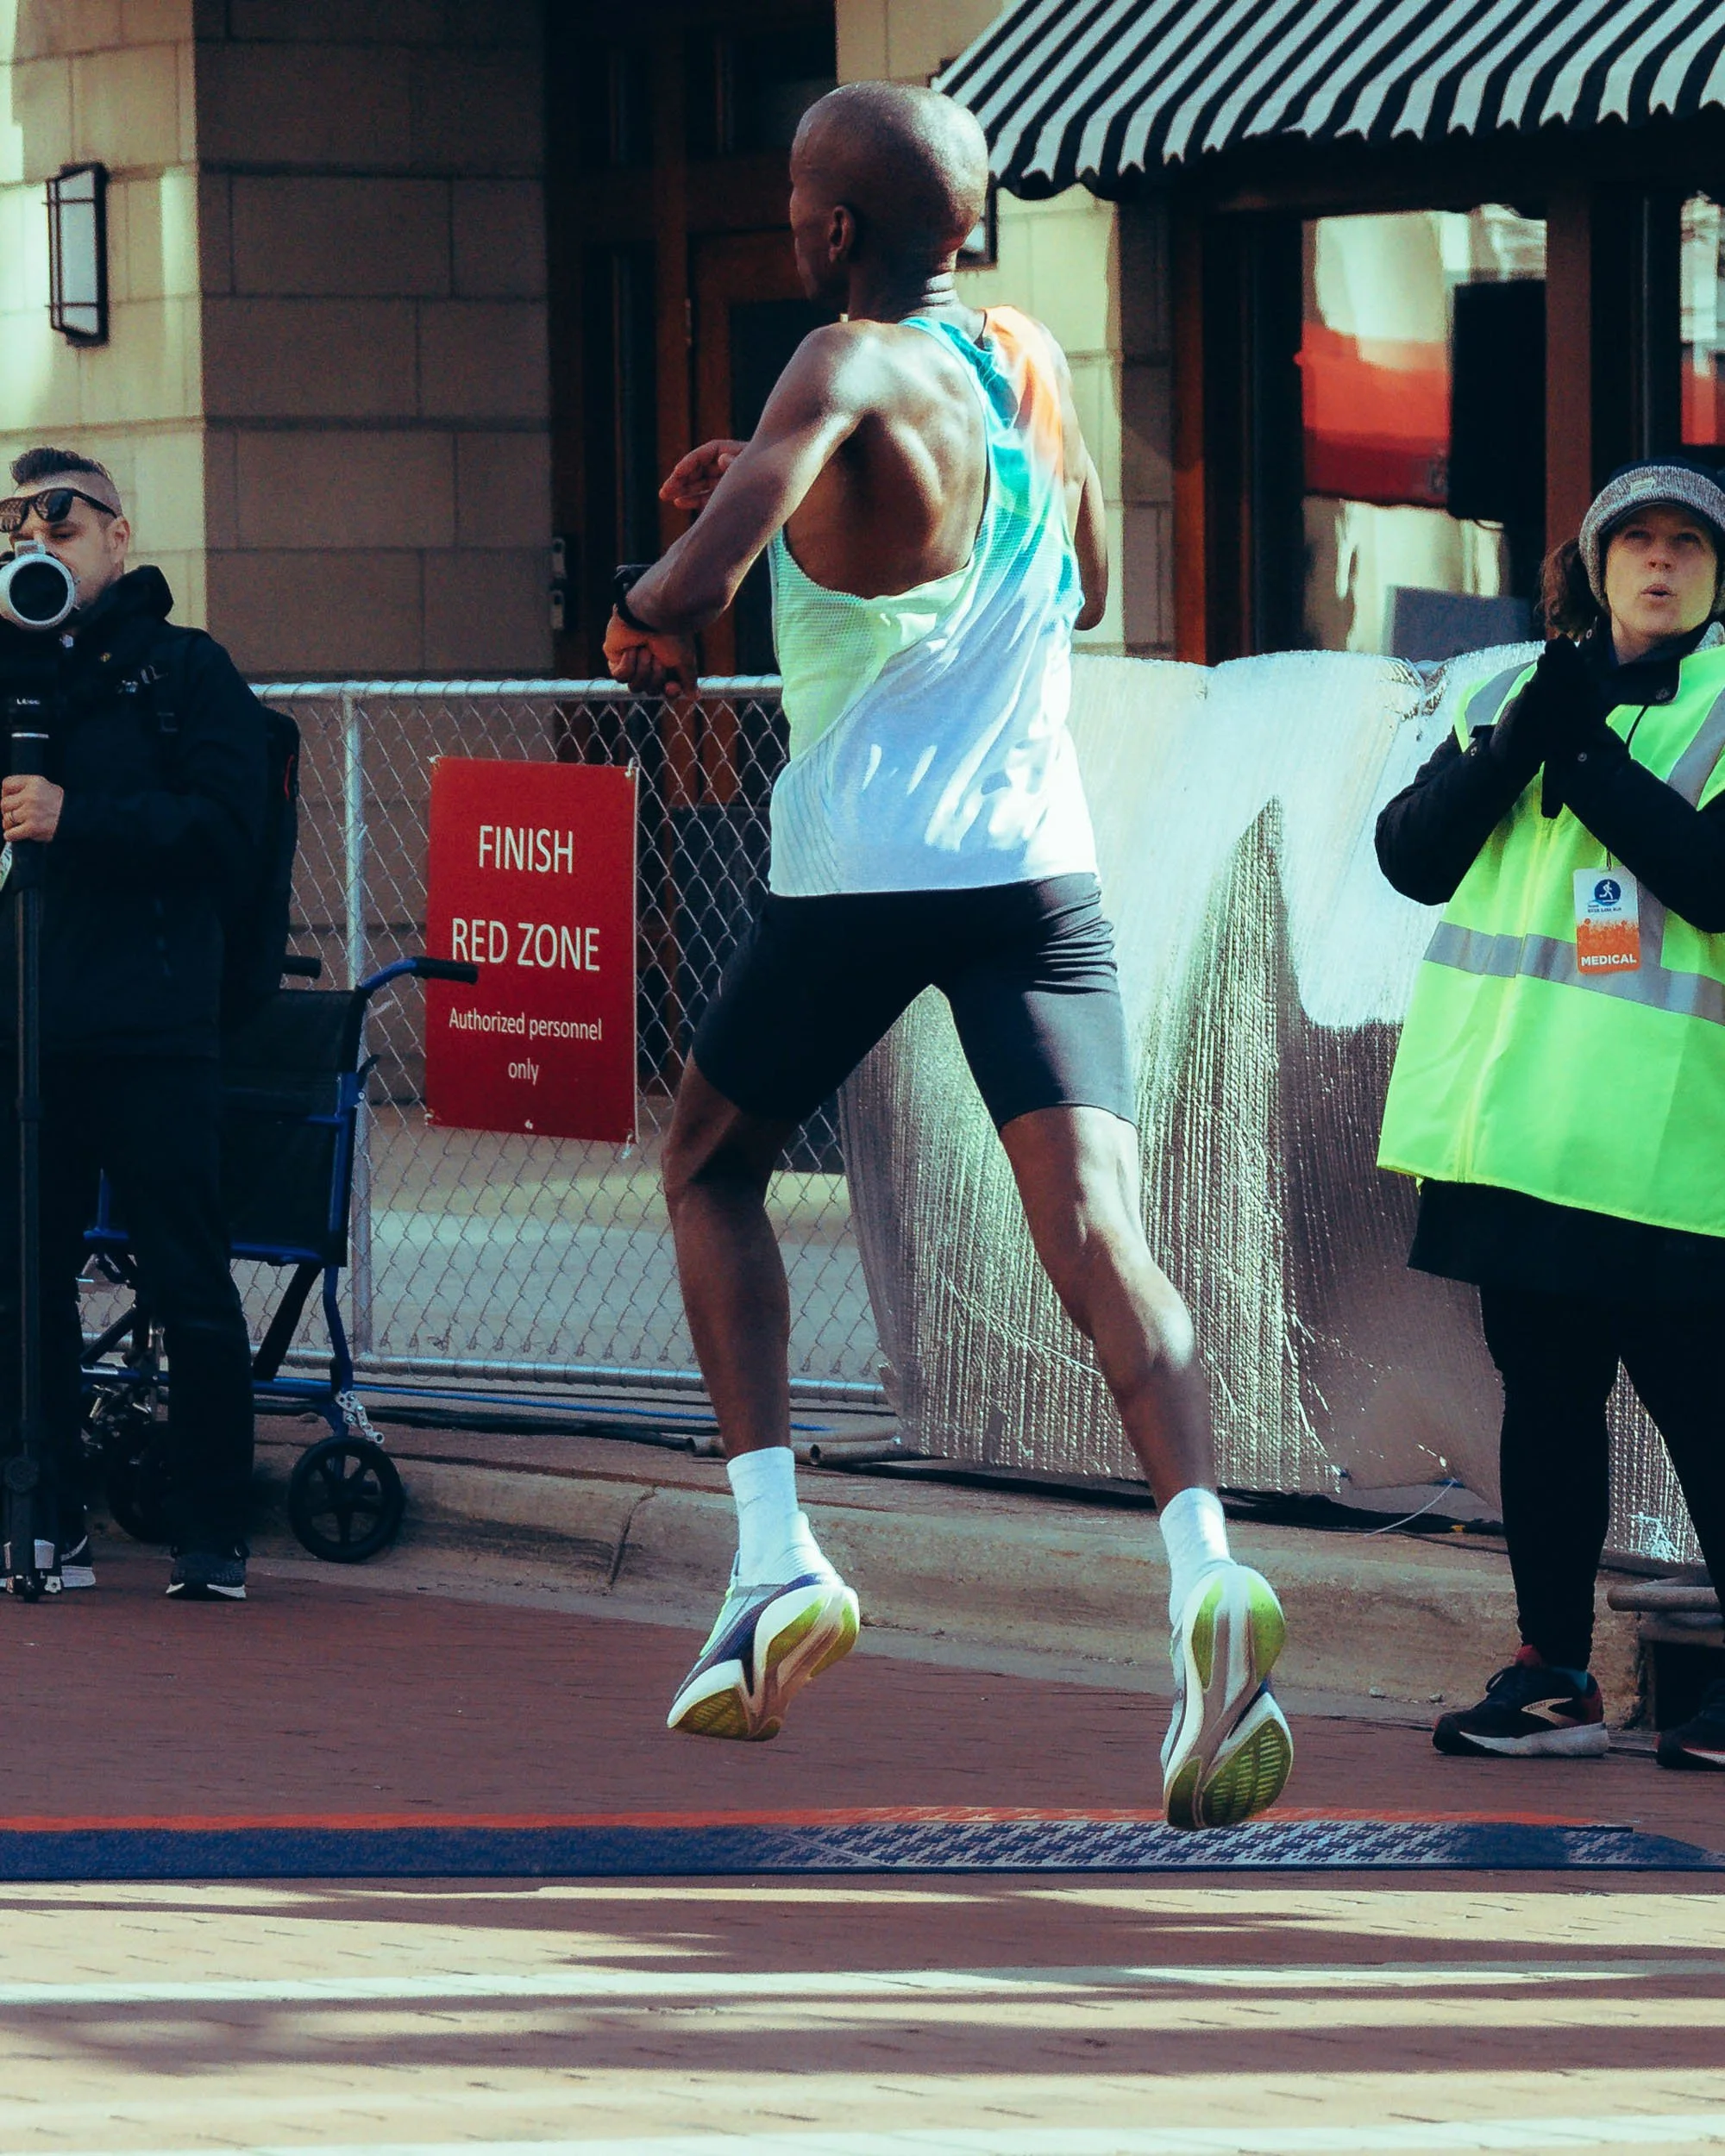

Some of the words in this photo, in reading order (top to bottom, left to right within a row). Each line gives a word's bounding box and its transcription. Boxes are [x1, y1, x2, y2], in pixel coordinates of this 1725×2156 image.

[479, 825, 574, 874] FINISH
[452, 918, 508, 963] RED
[518, 922, 600, 971] ZONE
[1581, 953, 1637, 966] MEDICAL
[449, 1007, 525, 1034] Authorized
[529, 1018, 602, 1040] personnel
[508, 1057, 540, 1086] only
